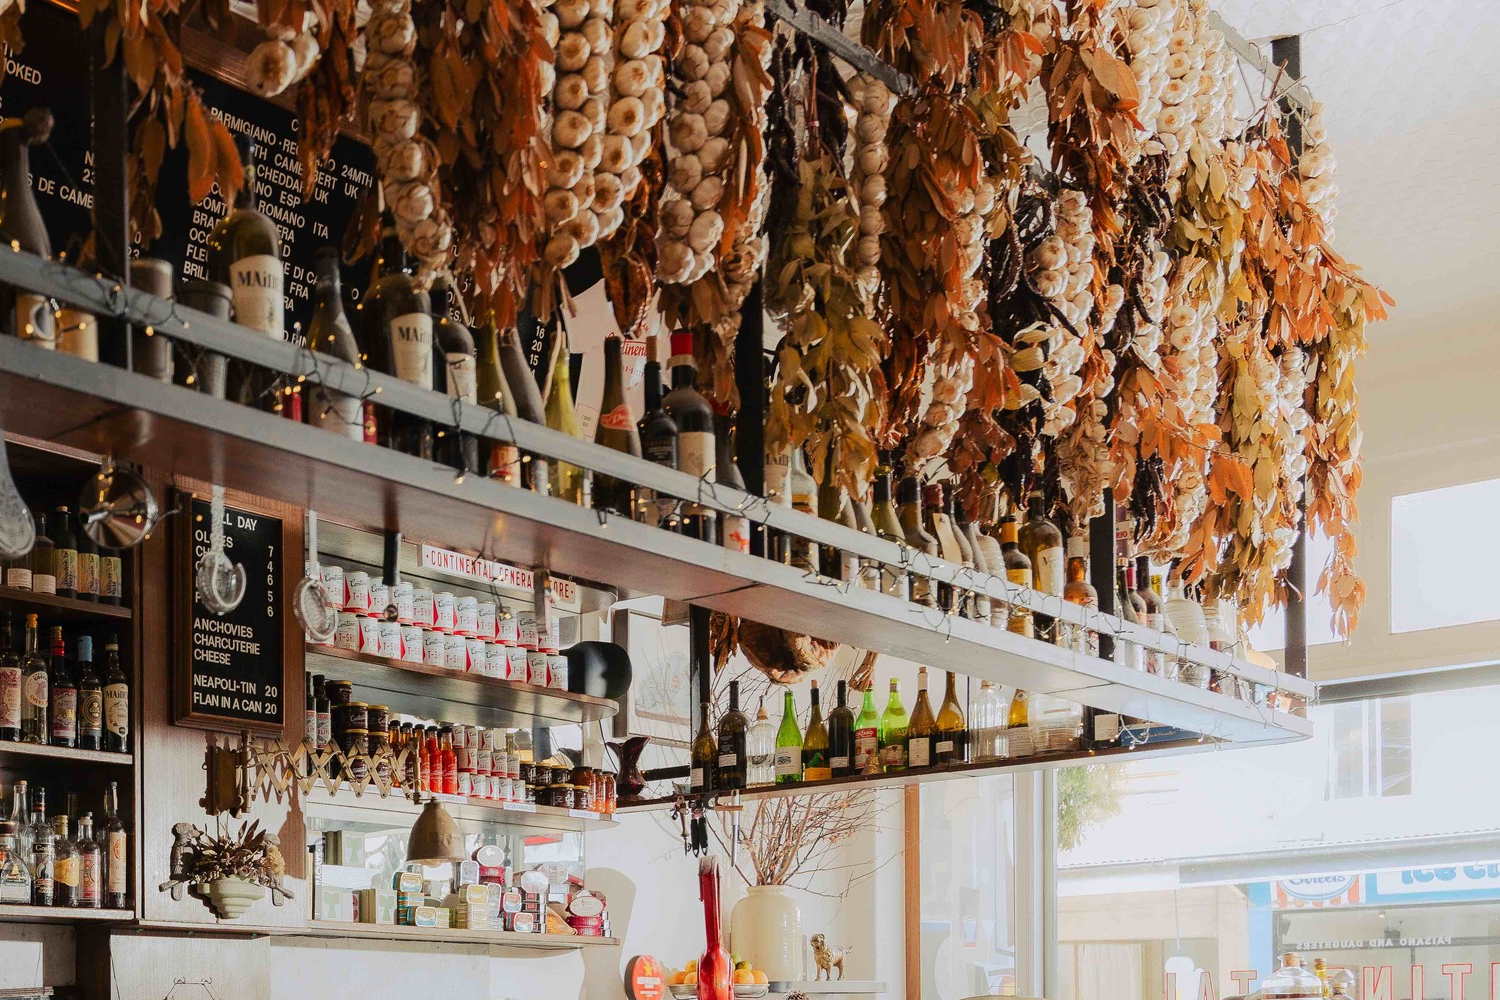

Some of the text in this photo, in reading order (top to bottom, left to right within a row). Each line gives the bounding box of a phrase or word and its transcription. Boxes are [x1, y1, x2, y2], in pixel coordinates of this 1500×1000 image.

[210, 107, 373, 187] PARMIGIANO 24MTH
[39, 177, 55, 195] DE
[344, 184, 359, 199] UK
[314, 188, 329, 204] UK
[258, 201, 329, 239] ROMANO ITA
[290, 283, 309, 299] FRA
[536, 326, 545, 339] 16
[532, 339, 542, 352] 20
[530, 353, 538, 366] 15
[221, 513, 258, 532] LL DAY
[195, 530, 274, 558] OLES 7
[267, 561, 274, 572] 4
[431, 550, 570, 598] CONTINENTAL GENERA ORE
[267, 574, 274, 586] 6
[267, 590, 274, 602] 5
[267, 606, 274, 618] 6
[193, 617, 254, 639] ANCHOVIES
[194, 632, 260, 655] CHARCUTERIE
[194, 648, 231, 666] CHEESE
[194, 673, 278, 698] NEAPOLI-TIN 20
[194, 691, 277, 715] FLAN IN A CAN 20
